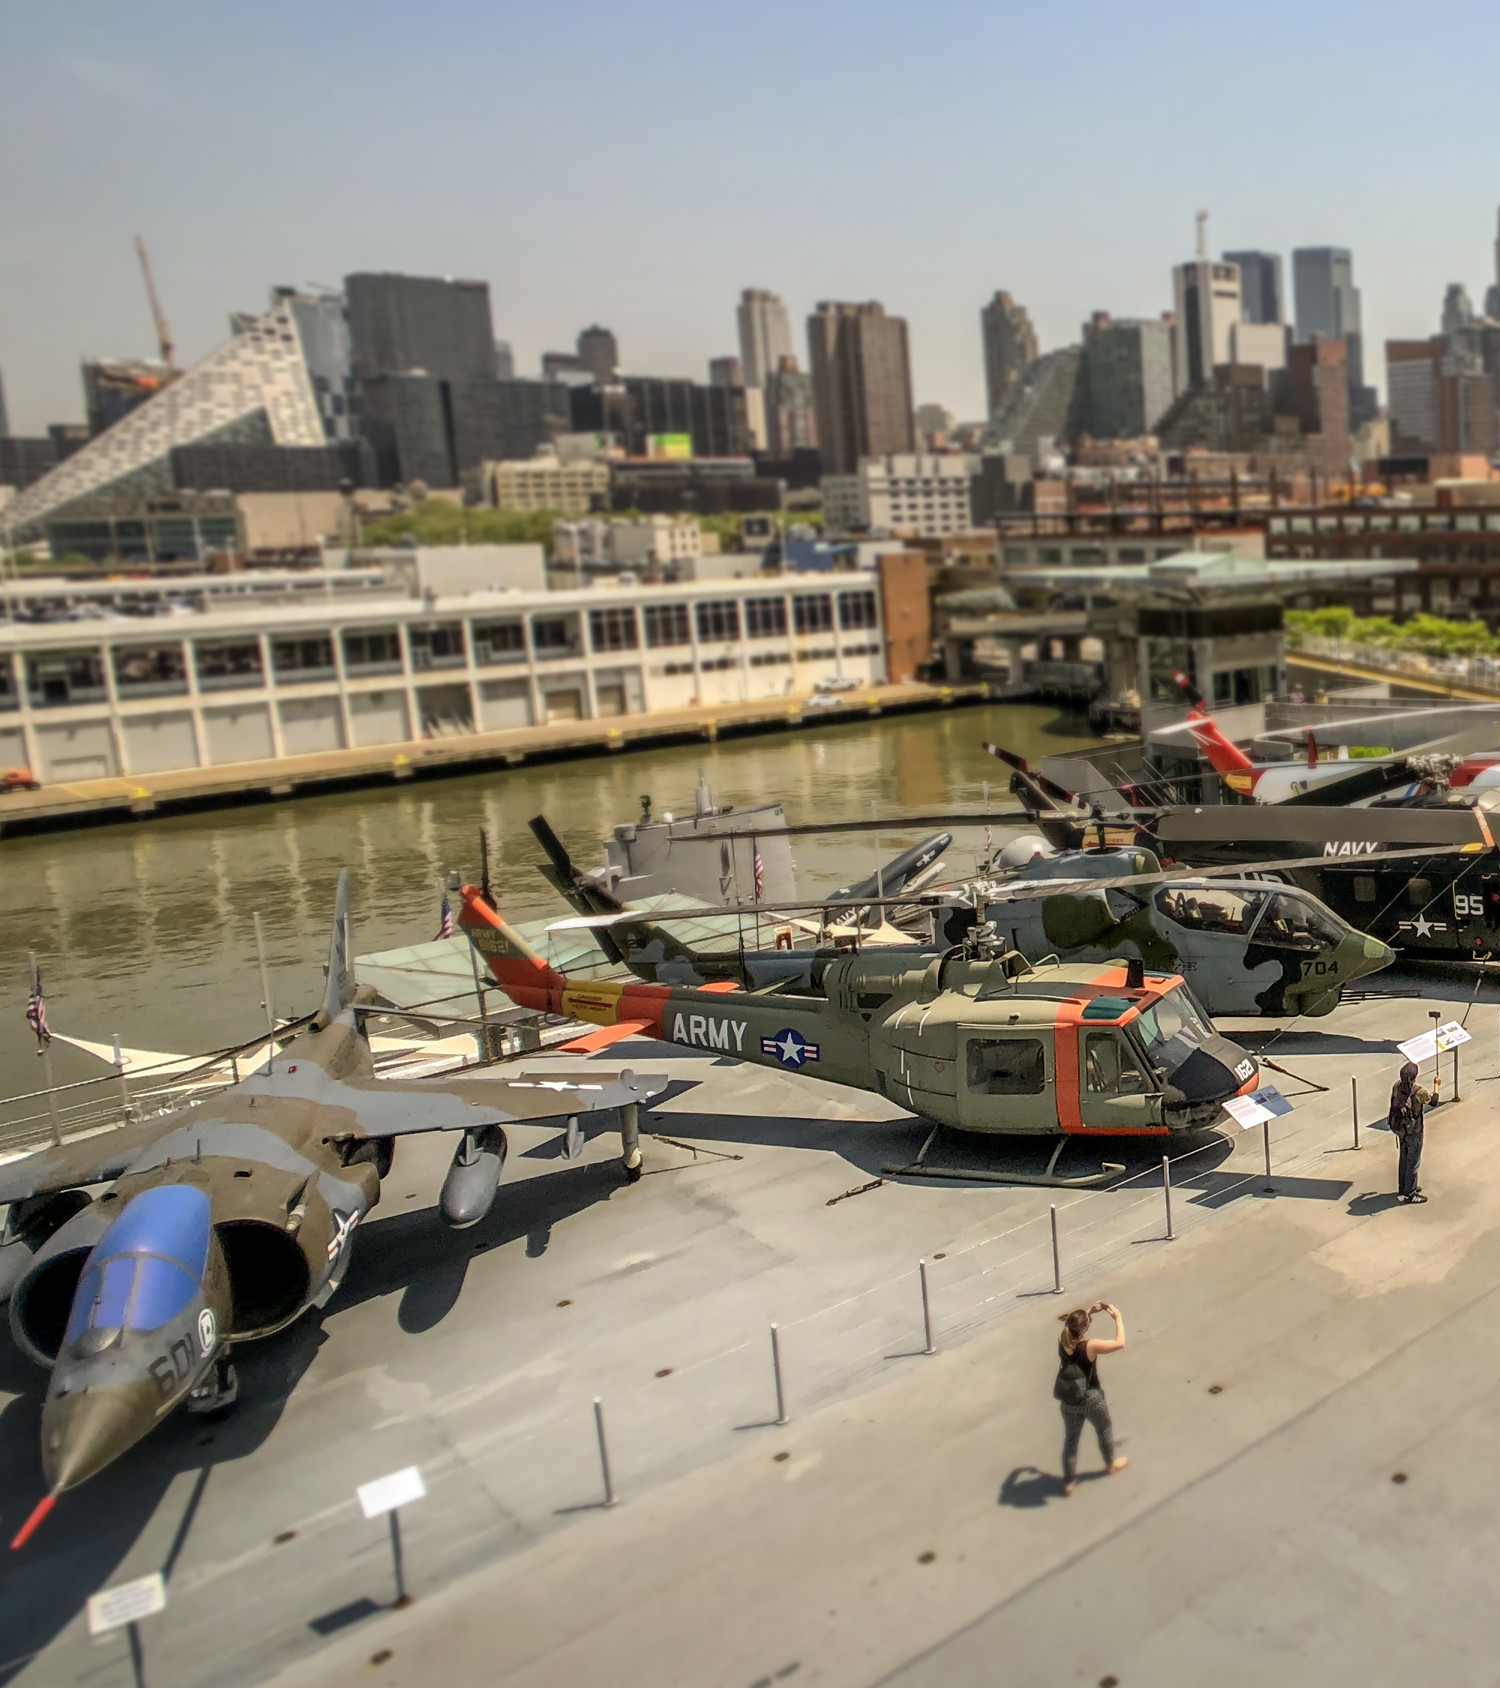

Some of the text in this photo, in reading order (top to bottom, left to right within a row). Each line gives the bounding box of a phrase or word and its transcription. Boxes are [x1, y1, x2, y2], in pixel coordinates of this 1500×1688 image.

[1323, 841, 1378, 857] NAVY
[1456, 895, 1484, 916] 95
[1302, 960, 1339, 977] 704
[672, 1012, 748, 1051] ARMY
